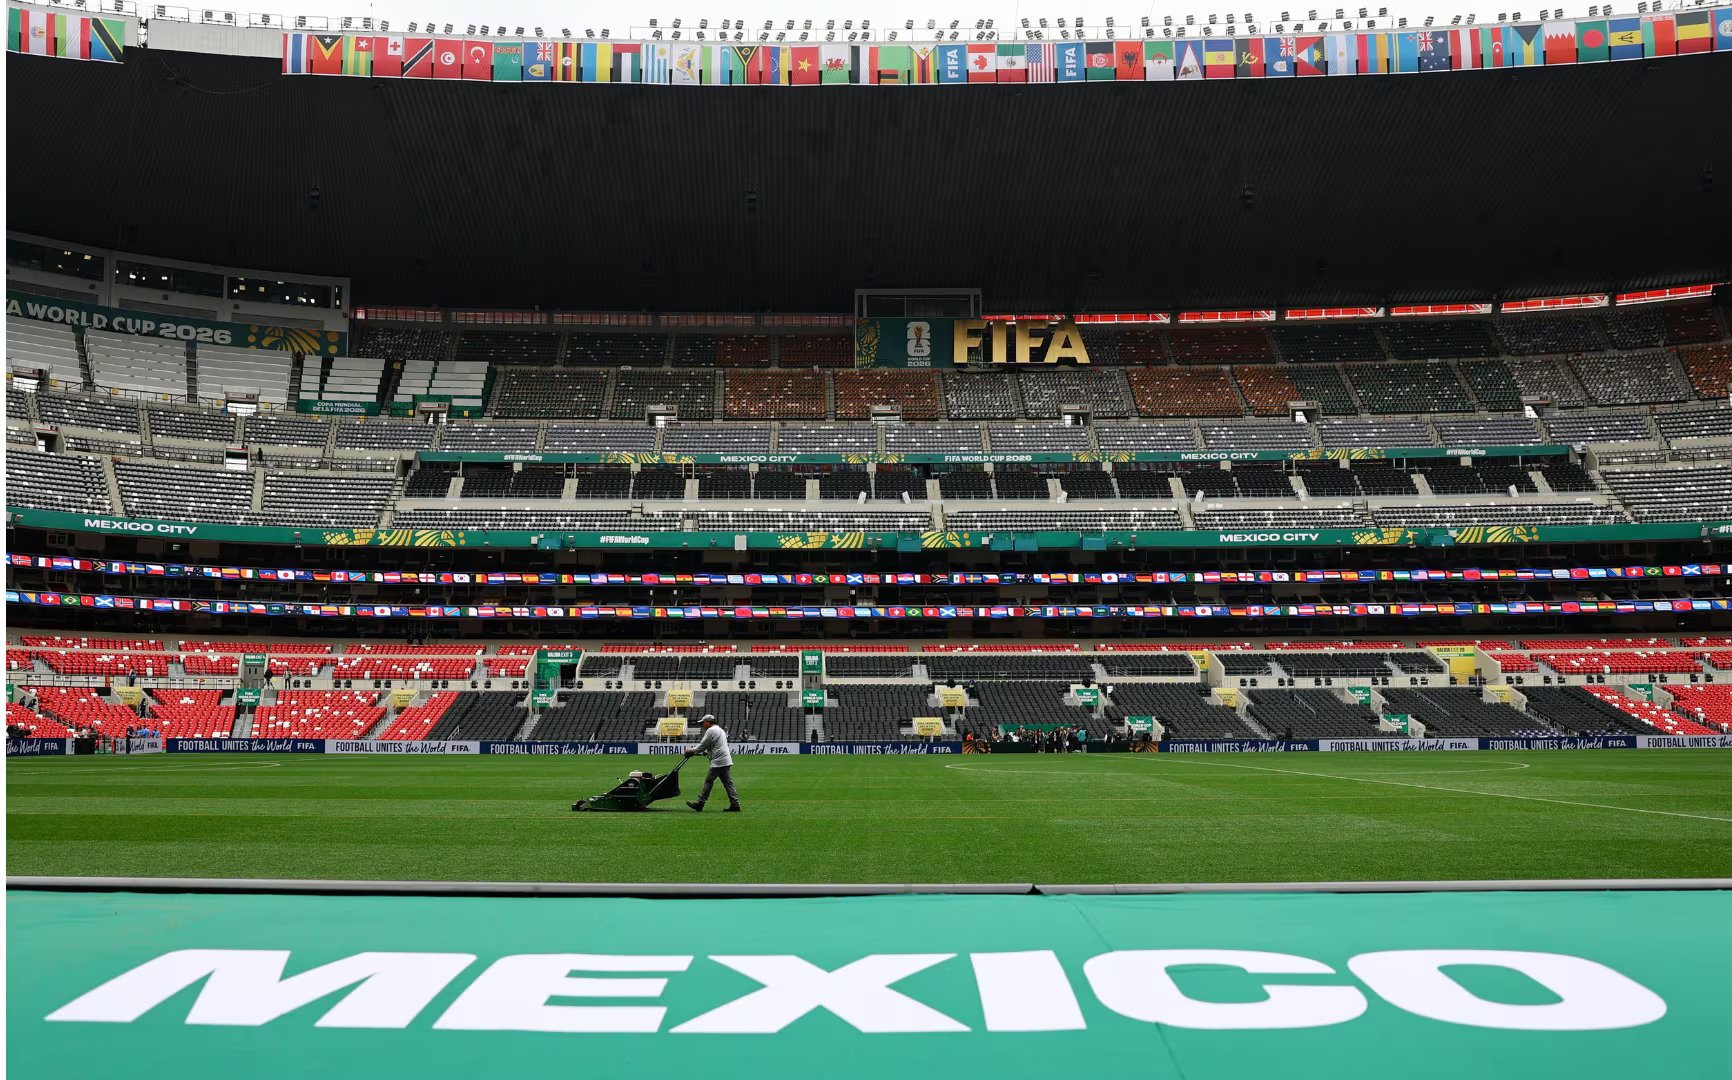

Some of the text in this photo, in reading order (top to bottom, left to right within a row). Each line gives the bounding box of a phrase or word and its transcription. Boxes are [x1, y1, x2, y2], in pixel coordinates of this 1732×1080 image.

[947, 48, 958, 78] FIFA
[1065, 48, 1076, 77] FIFA
[6, 299, 232, 344] A WORLD CUP 2026
[954, 319, 1091, 363] FIFA
[84, 519, 197, 534] MEXICO CITY
[600, 536, 649, 544] #FIFAWorldCup
[1220, 533, 1320, 542] MEXICO CITY
[20, 739, 41, 753] World
[178, 741, 219, 751] FOOTBALL
[222, 741, 249, 751] UNITES
[250, 740, 265, 751] the
[266, 739, 293, 752] World
[336, 742, 373, 752] FOOTBALL
[376, 742, 402, 752] UNITES
[404, 741, 420, 753] the
[420, 741, 447, 753] World
[1169, 744, 1208, 752] FOOTBALL
[1211, 744, 1239, 752] UNITES
[1240, 742, 1257, 752] the
[1258, 742, 1285, 752] World
[1330, 742, 1369, 751] FOOTBALL
[1372, 742, 1399, 751] UNITES
[1401, 741, 1417, 751] the
[1417, 740, 1445, 751] World
[1489, 740, 1528, 750] FOOTBALL
[1530, 740, 1558, 750] UNITES
[1559, 740, 1576, 750] the
[1576, 738, 1604, 749] World
[1647, 738, 1686, 747] FOOTBALL
[1689, 737, 1716, 747] UNITES
[490, 744, 529, 754] FOOTBALL
[532, 744, 559, 754] UNITES
[560, 744, 576, 754] the
[577, 744, 605, 754] World
[738, 744, 765, 754] World
[811, 745, 850, 754] FOOTBALL
[853, 745, 882, 754] UNITES
[883, 744, 899, 754] the
[900, 744, 928, 754] World
[45, 949, 1667, 1034] MEXICO
